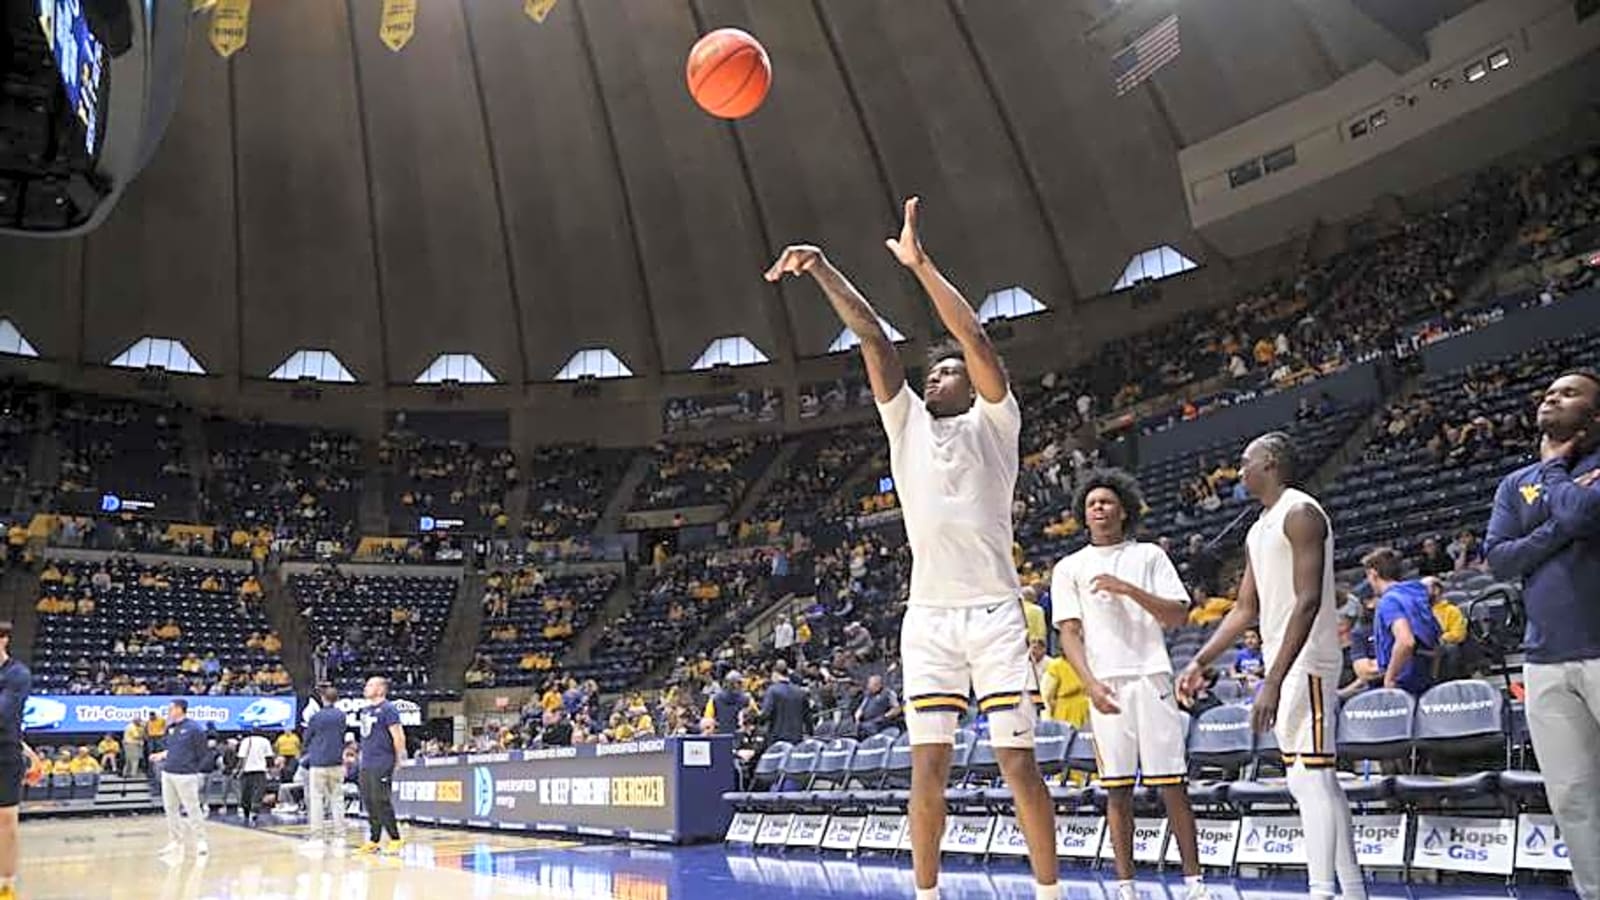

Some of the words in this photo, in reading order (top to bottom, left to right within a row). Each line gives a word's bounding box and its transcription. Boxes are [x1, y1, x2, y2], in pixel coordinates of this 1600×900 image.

[962, 823, 988, 836] Hope
[1067, 823, 1099, 837] Hope
[1134, 828, 1160, 840] ope
[958, 835, 978, 845] Gas
[1063, 836, 1086, 848] Gas
[1450, 828, 1508, 847] Hope
[1263, 841, 1294, 853] Gas
[1448, 844, 1489, 861] Gas
